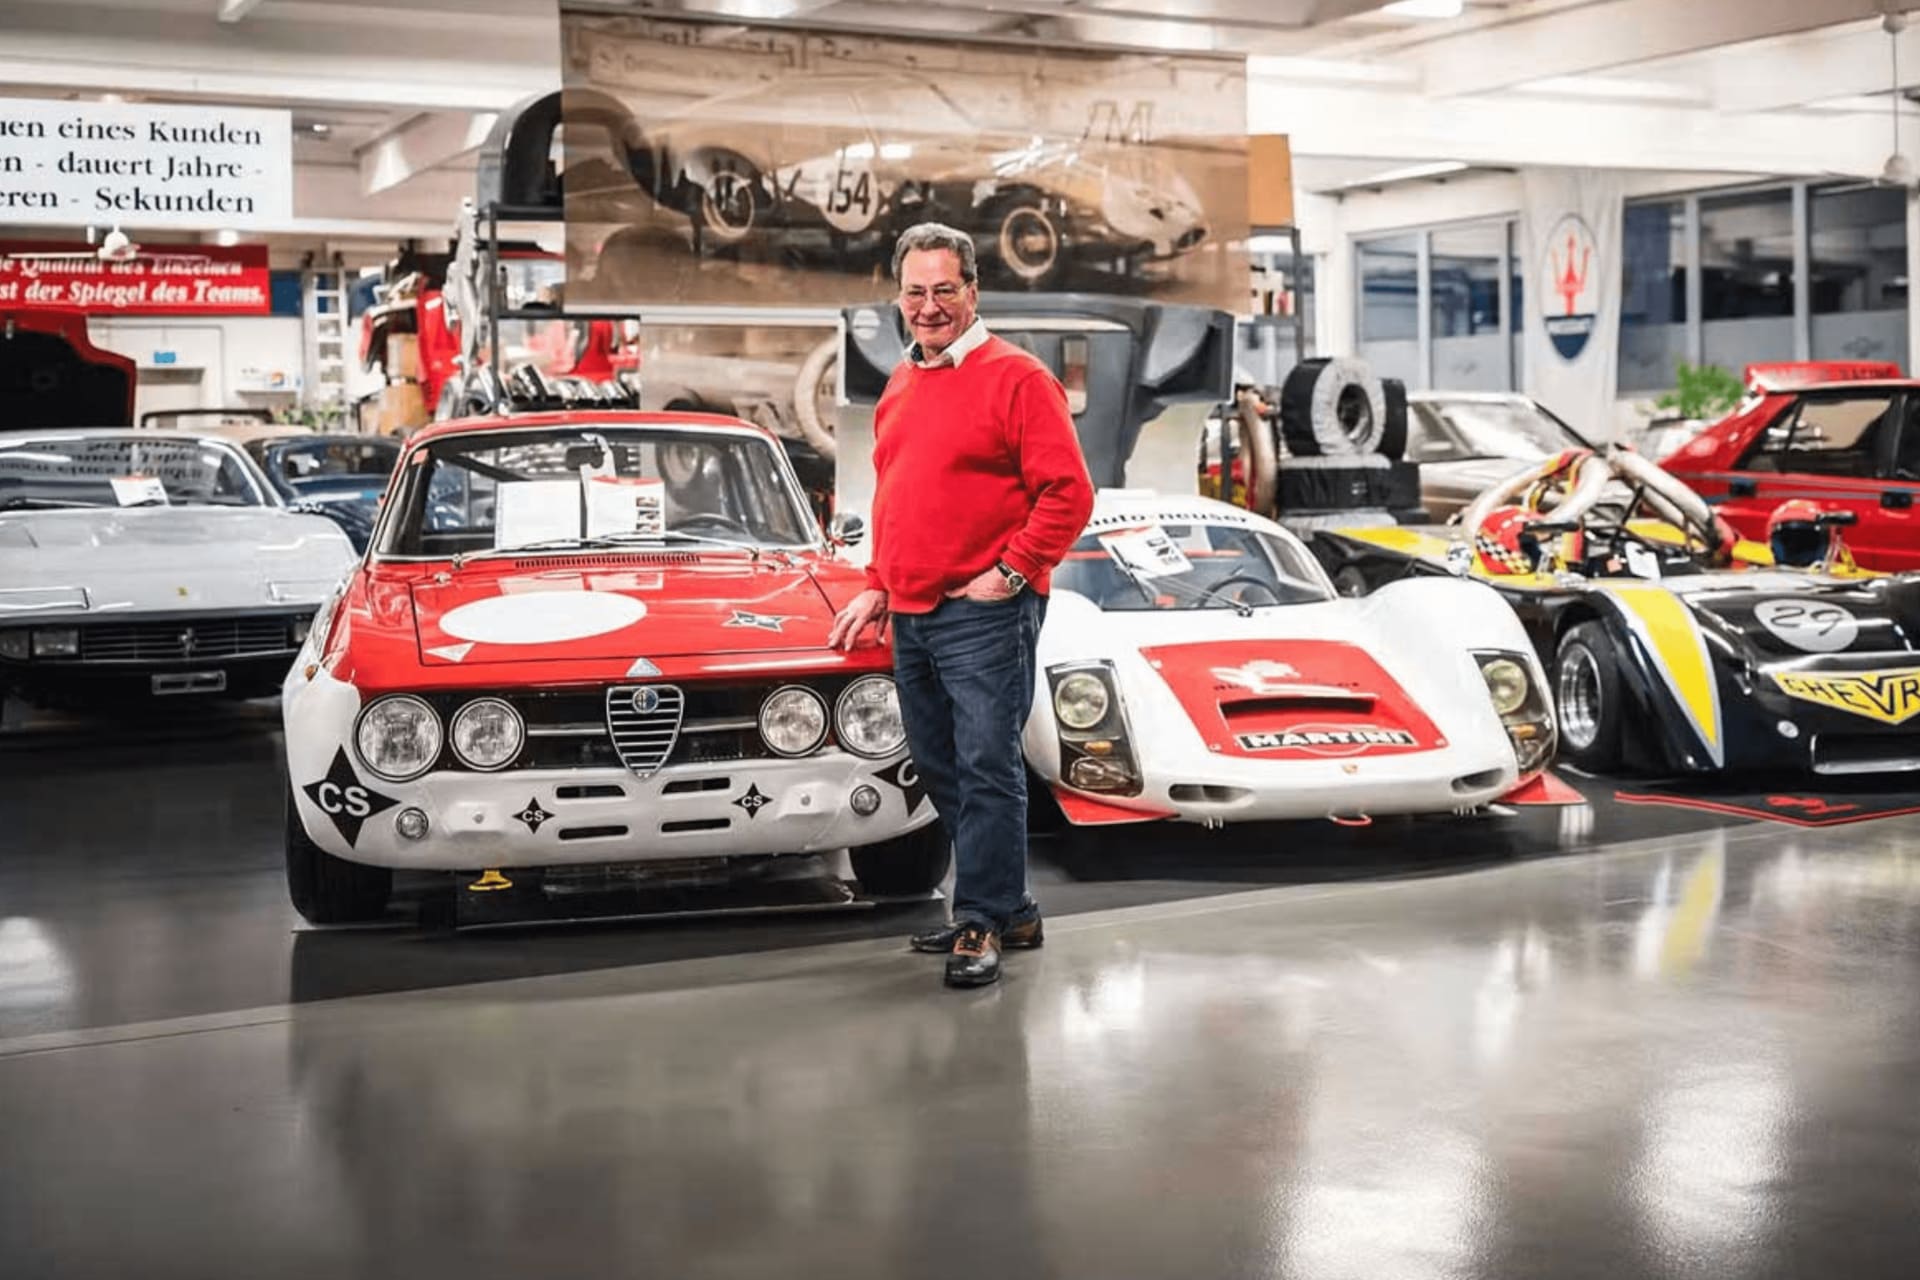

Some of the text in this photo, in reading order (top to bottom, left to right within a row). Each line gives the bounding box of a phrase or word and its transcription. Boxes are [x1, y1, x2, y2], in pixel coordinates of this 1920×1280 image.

[58, 117, 136, 140] eines
[149, 121, 262, 145] Kunden
[0, 155, 22, 172] n
[58, 151, 153, 176] dauert
[162, 155, 243, 182] Jahre
[95, 186, 254, 213] Sekunden
[827, 169, 870, 216] 154
[24, 280, 63, 301] der
[68, 280, 147, 307] Spiegel
[152, 281, 188, 303] des
[194, 279, 266, 304] Teams.
[1770, 606, 1843, 637] 29
[1784, 676, 1920, 716] CHEVR
[1246, 730, 1410, 748] MARTINI
[319, 782, 370, 817] CS
[742, 795, 763, 807] CS
[522, 810, 545, 822] CS
